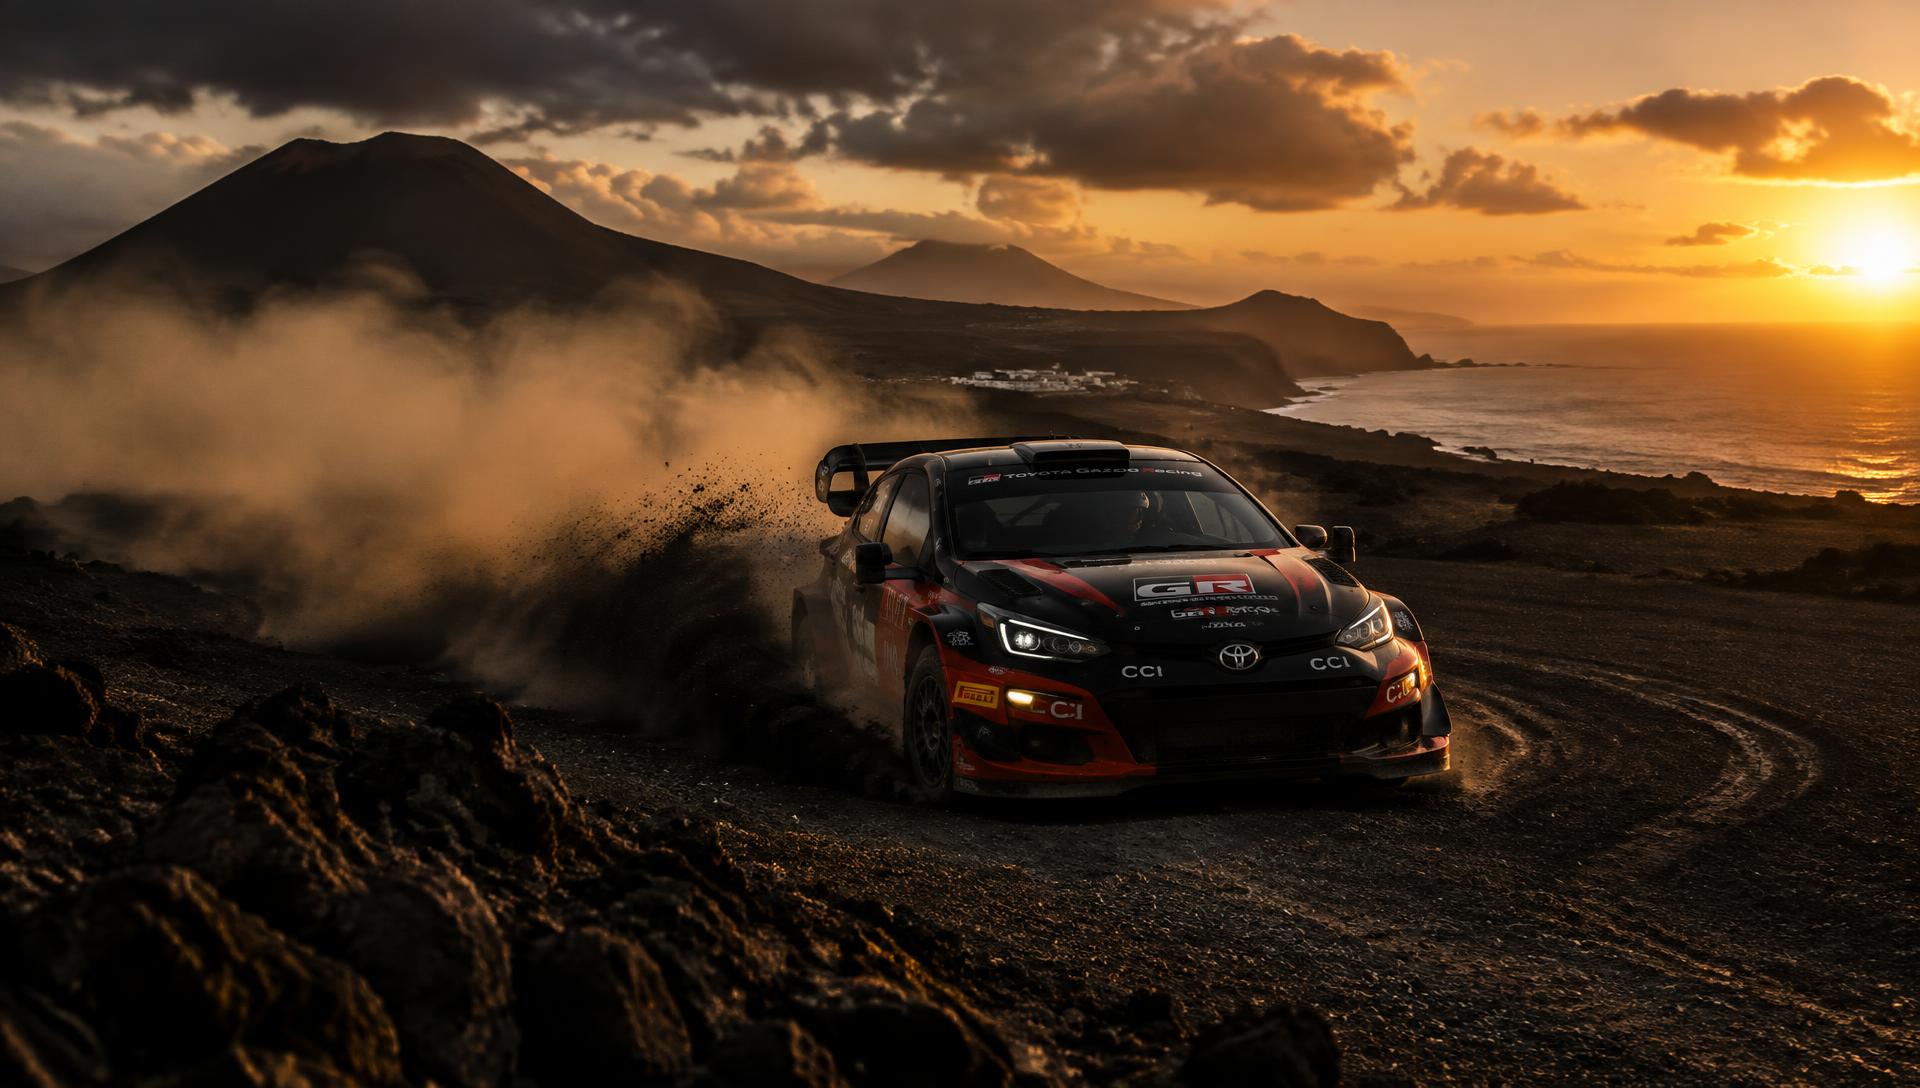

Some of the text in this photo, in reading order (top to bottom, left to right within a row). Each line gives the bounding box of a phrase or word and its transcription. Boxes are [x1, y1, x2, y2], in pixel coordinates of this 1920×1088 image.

[1004, 469, 1072, 479] TOYOTA
[1136, 579, 1249, 598] GR
[1309, 656, 1351, 671] CCI
[1120, 665, 1164, 679] CCI
